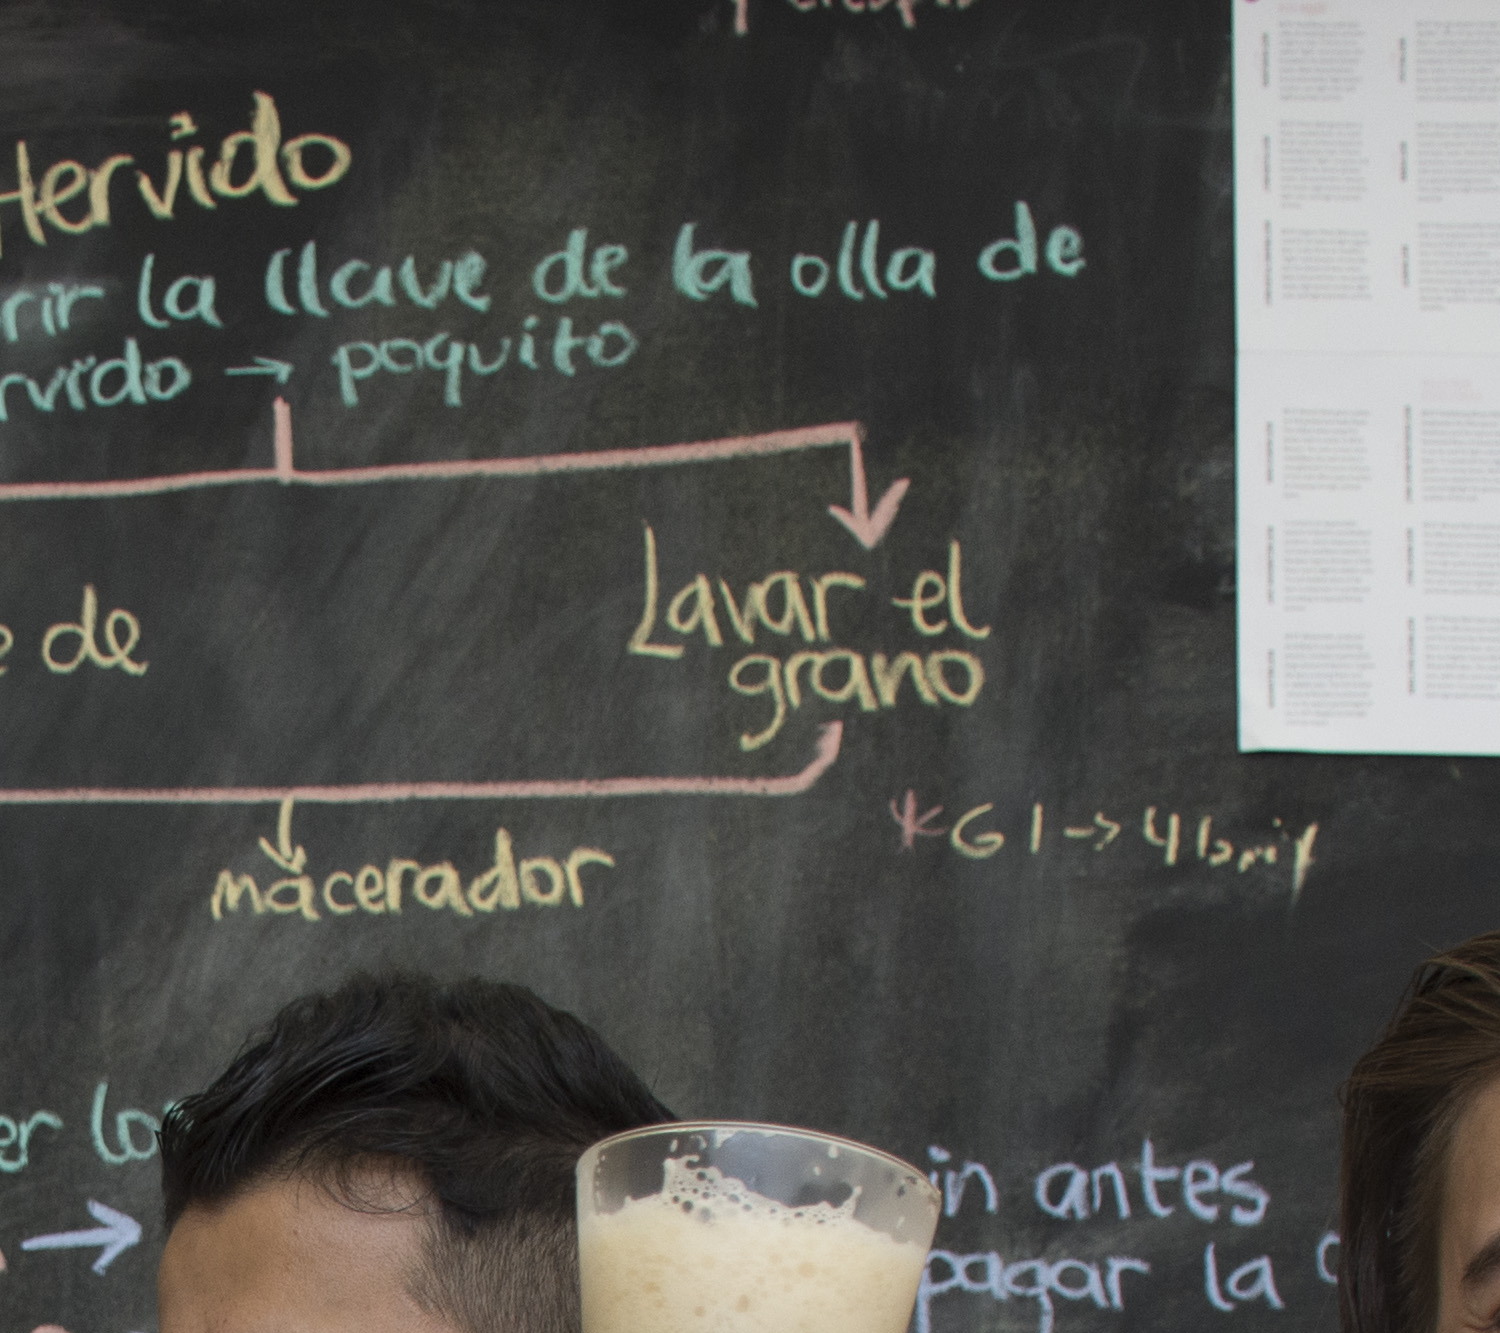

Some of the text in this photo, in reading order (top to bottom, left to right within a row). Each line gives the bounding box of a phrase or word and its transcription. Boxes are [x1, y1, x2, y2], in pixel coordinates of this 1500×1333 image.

[138, 253, 220, 328] la
[265, 239, 490, 314] llave
[534, 227, 628, 302] de
[672, 222, 759, 309] la
[790, 219, 937, 299] olla
[978, 201, 1088, 280] de
[330, 314, 637, 406] poquito
[42, 584, 148, 678] de
[628, 524, 991, 661] Lavar el
[729, 644, 986, 752] grano
[211, 826, 615, 919] macerador
[927, 1136, 1270, 1225] in antes
[1205, 1242, 1285, 1311] la
